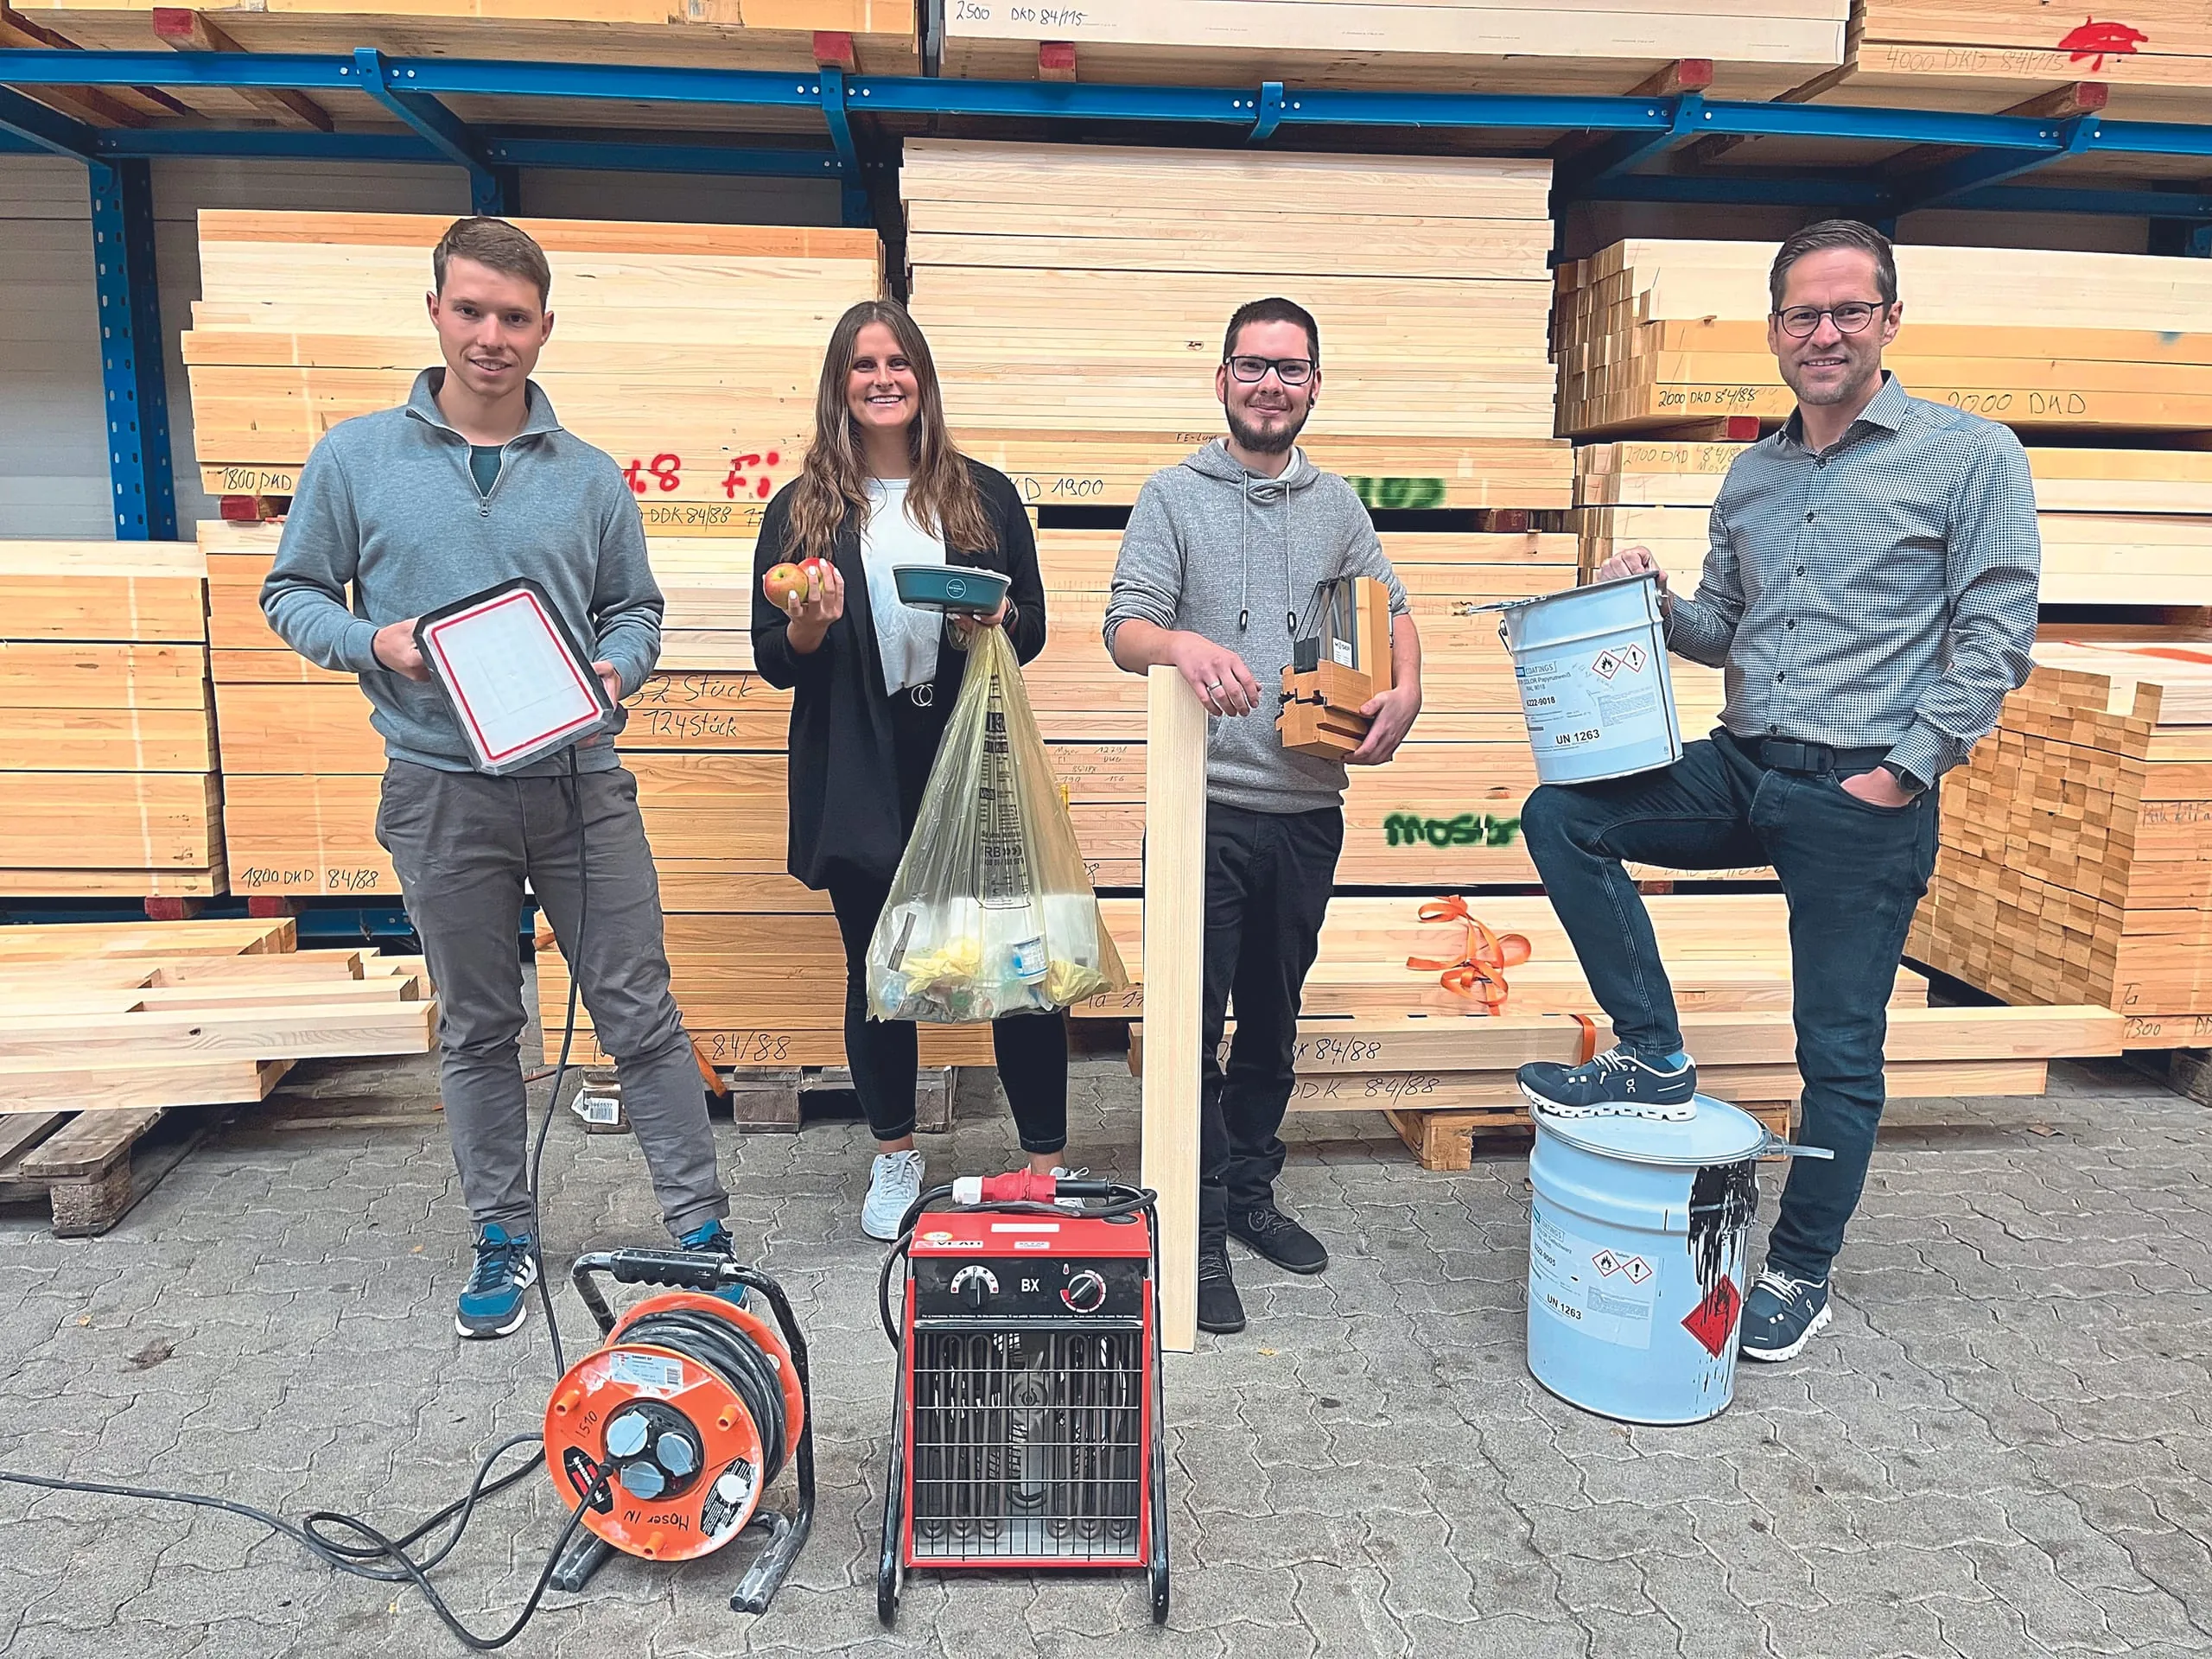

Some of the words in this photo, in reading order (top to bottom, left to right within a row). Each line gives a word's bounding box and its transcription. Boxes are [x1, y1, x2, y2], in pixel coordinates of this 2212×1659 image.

[956, 0, 990, 20] 2500
[1011, 7, 1036, 22] DKD
[1039, 5, 1088, 27] 84/115
[1887, 45, 1935, 72] 4000
[1658, 390, 1685, 407] 2000
[1690, 391, 1711, 404] DKD
[219, 467, 256, 490] 1800
[1051, 477, 1104, 499] 1900
[651, 507, 683, 524] DDK
[686, 505, 733, 532] 84/88
[683, 674, 753, 702] Stück
[690, 713, 737, 738] Stück
[1555, 734, 1572, 745] UN
[1573, 728, 1600, 743] 1263
[241, 868, 279, 888] 1800
[283, 869, 315, 885] DKD
[327, 868, 379, 892] 84/88
[712, 1031, 791, 1061] 84/88
[1315, 1035, 1382, 1065] 84/88
[1364, 1071, 1440, 1105] 84/88
[1020, 1278, 1040, 1293] BX
[1547, 1294, 1559, 1308] UN
[1560, 1302, 1582, 1320] 1263
[646, 1512, 690, 1532] Moser
